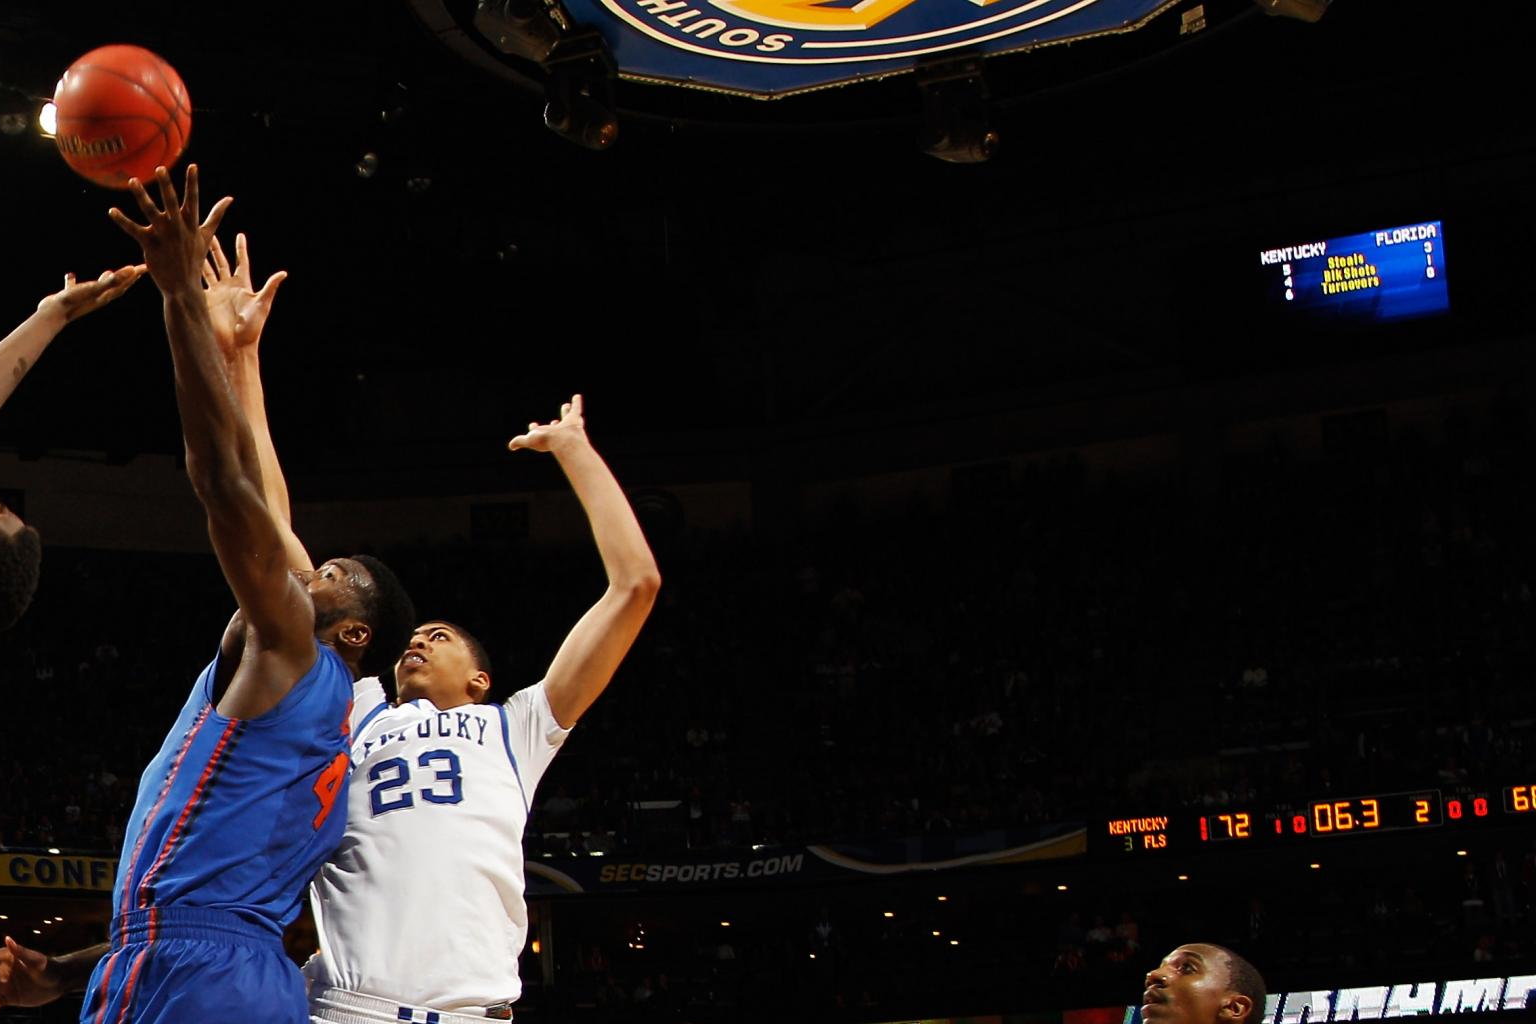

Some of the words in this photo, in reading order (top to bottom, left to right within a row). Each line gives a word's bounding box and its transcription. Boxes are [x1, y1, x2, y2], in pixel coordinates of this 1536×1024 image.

[1375, 224, 1437, 246] FLORIDA
[1260, 241, 1326, 265] KENTUCKY
[1423, 241, 1433, 254] 3
[1327, 253, 1365, 269] Steals
[1343, 264, 1377, 279] Shots
[1284, 276, 1293, 288] 4
[1321, 275, 1380, 295] Turnovers
[367, 748, 465, 819] 23
[1512, 785, 1536, 812] 6
[1313, 796, 1382, 834] 06.3
[1415, 800, 1432, 824] 2
[1108, 815, 1168, 835] KENTUCKY
[1218, 812, 1250, 838] 72
[1143, 834, 1167, 849] FLS
[598, 854, 804, 884] SECSPORTS.COM
